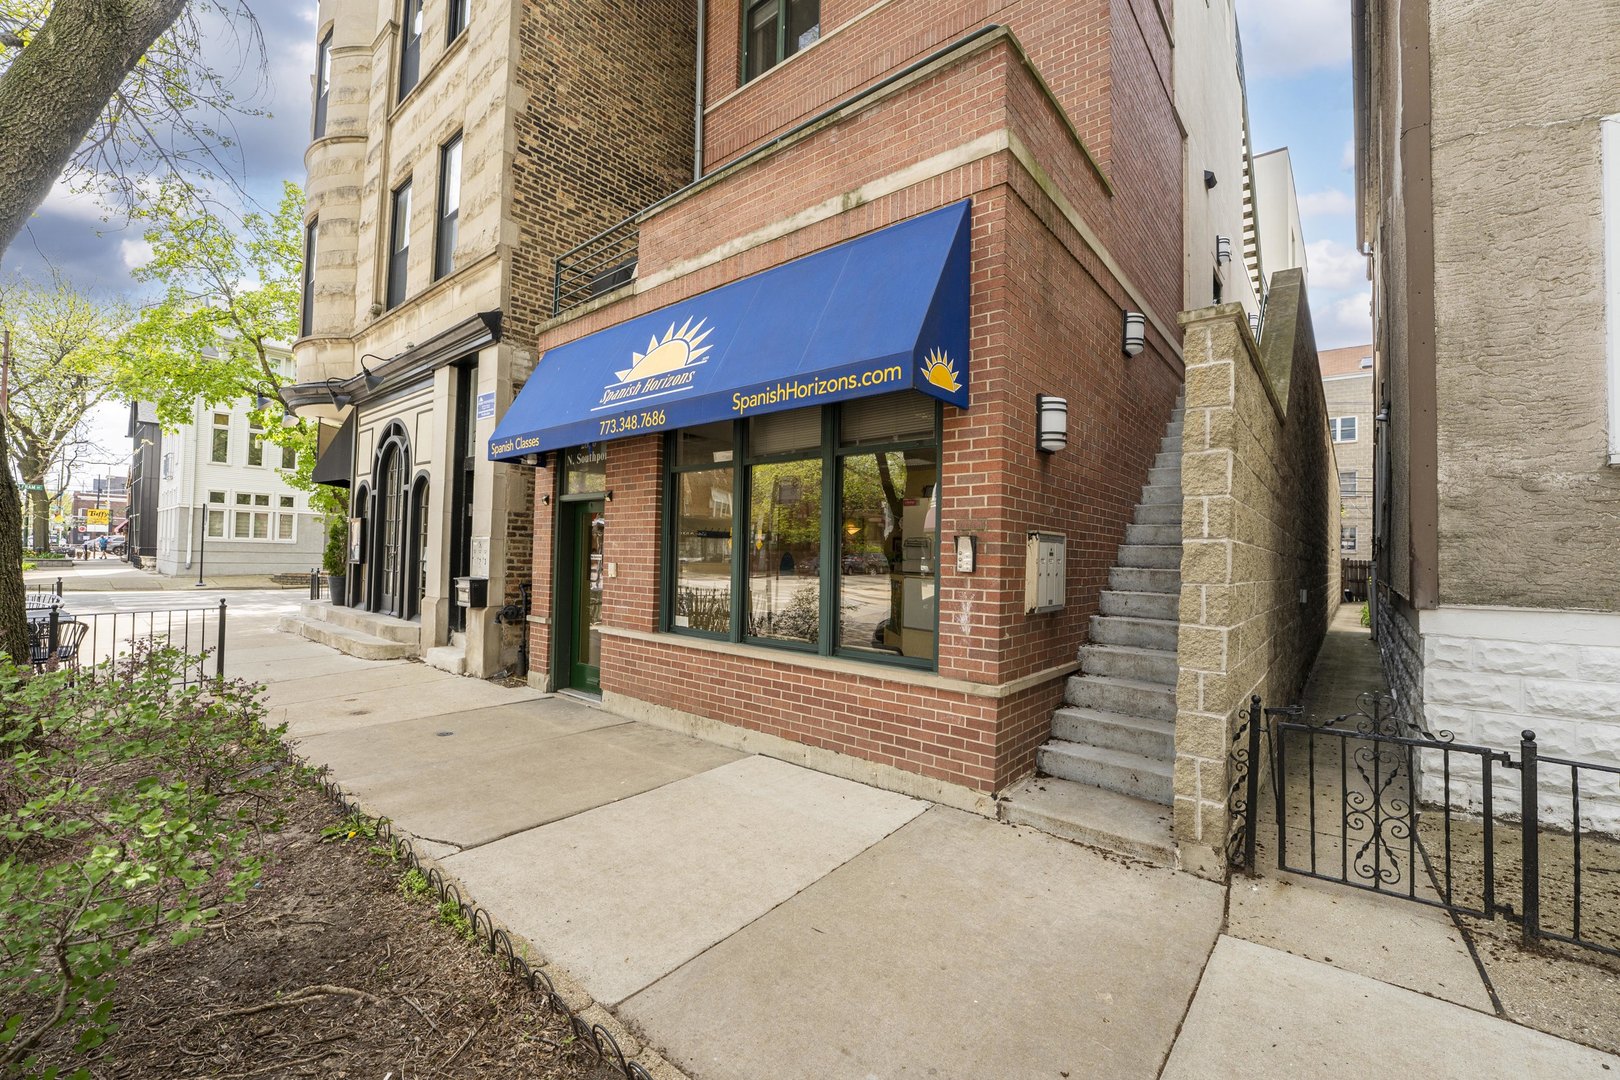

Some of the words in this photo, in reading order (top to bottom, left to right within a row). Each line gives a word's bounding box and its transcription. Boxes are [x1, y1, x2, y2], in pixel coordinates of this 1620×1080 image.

[600, 381, 641, 405] Spanish
[641, 370, 696, 394] Horizons
[732, 365, 902, 414] SpanishHorizons.com
[599, 409, 666, 436] 773.348.7686
[491, 437, 514, 456] Spanish
[515, 436, 540, 449] Classes
